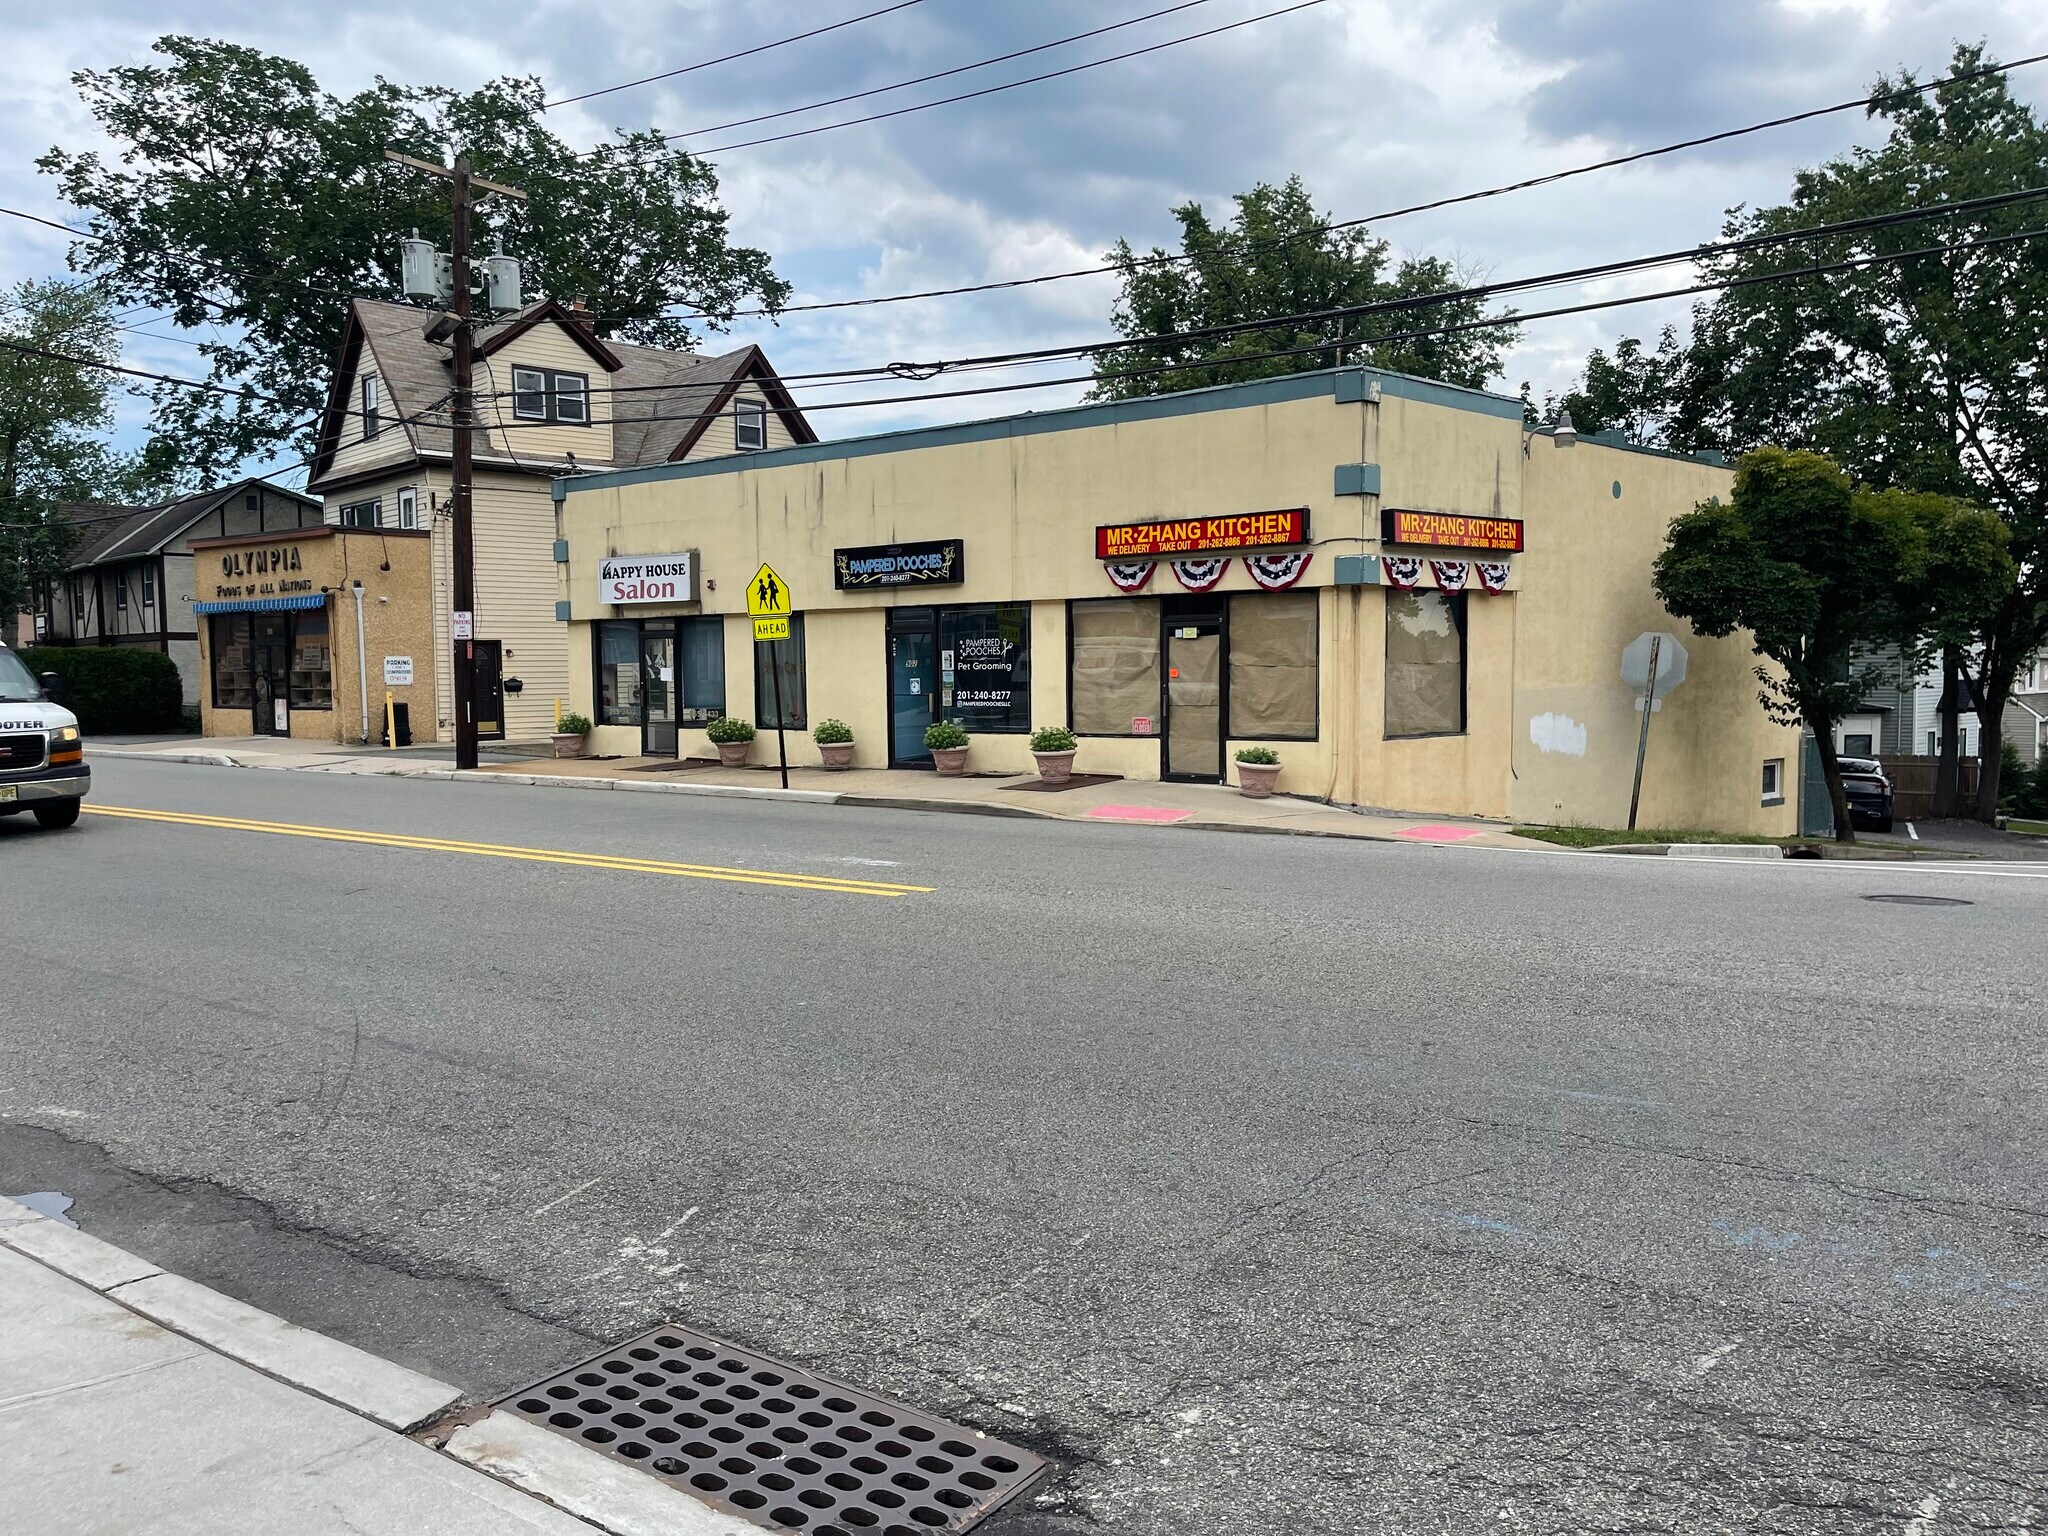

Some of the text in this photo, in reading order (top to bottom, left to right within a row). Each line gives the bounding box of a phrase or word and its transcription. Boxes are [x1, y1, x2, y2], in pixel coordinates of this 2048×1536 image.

[1207, 513, 1291, 538] KITCHEN
[1468, 519, 1517, 539] KITCHEN
[1107, 532, 1290, 555] WE DELIVERY TAKE OUT 201-262-8866 201-262-8867
[1410, 533, 1432, 543] DELIVERY
[1438, 535, 1449, 544] TAKE
[1450, 536, 1460, 545] OUT
[222, 546, 302, 577] OLYMPIA
[850, 554, 942, 574] PAMPERED POOCHES
[646, 563, 686, 577] HOUSE
[260, 582, 275, 594] ALL
[614, 580, 675, 600] Salon
[757, 623, 787, 635] AHEAD
[965, 638, 1000, 647] PAMPERED
[965, 646, 1000, 656] POOCHES
[957, 661, 1012, 672] Pet Grooming
[957, 691, 1011, 700] 201-240-8277
[0, 720, 44, 730] OTER
